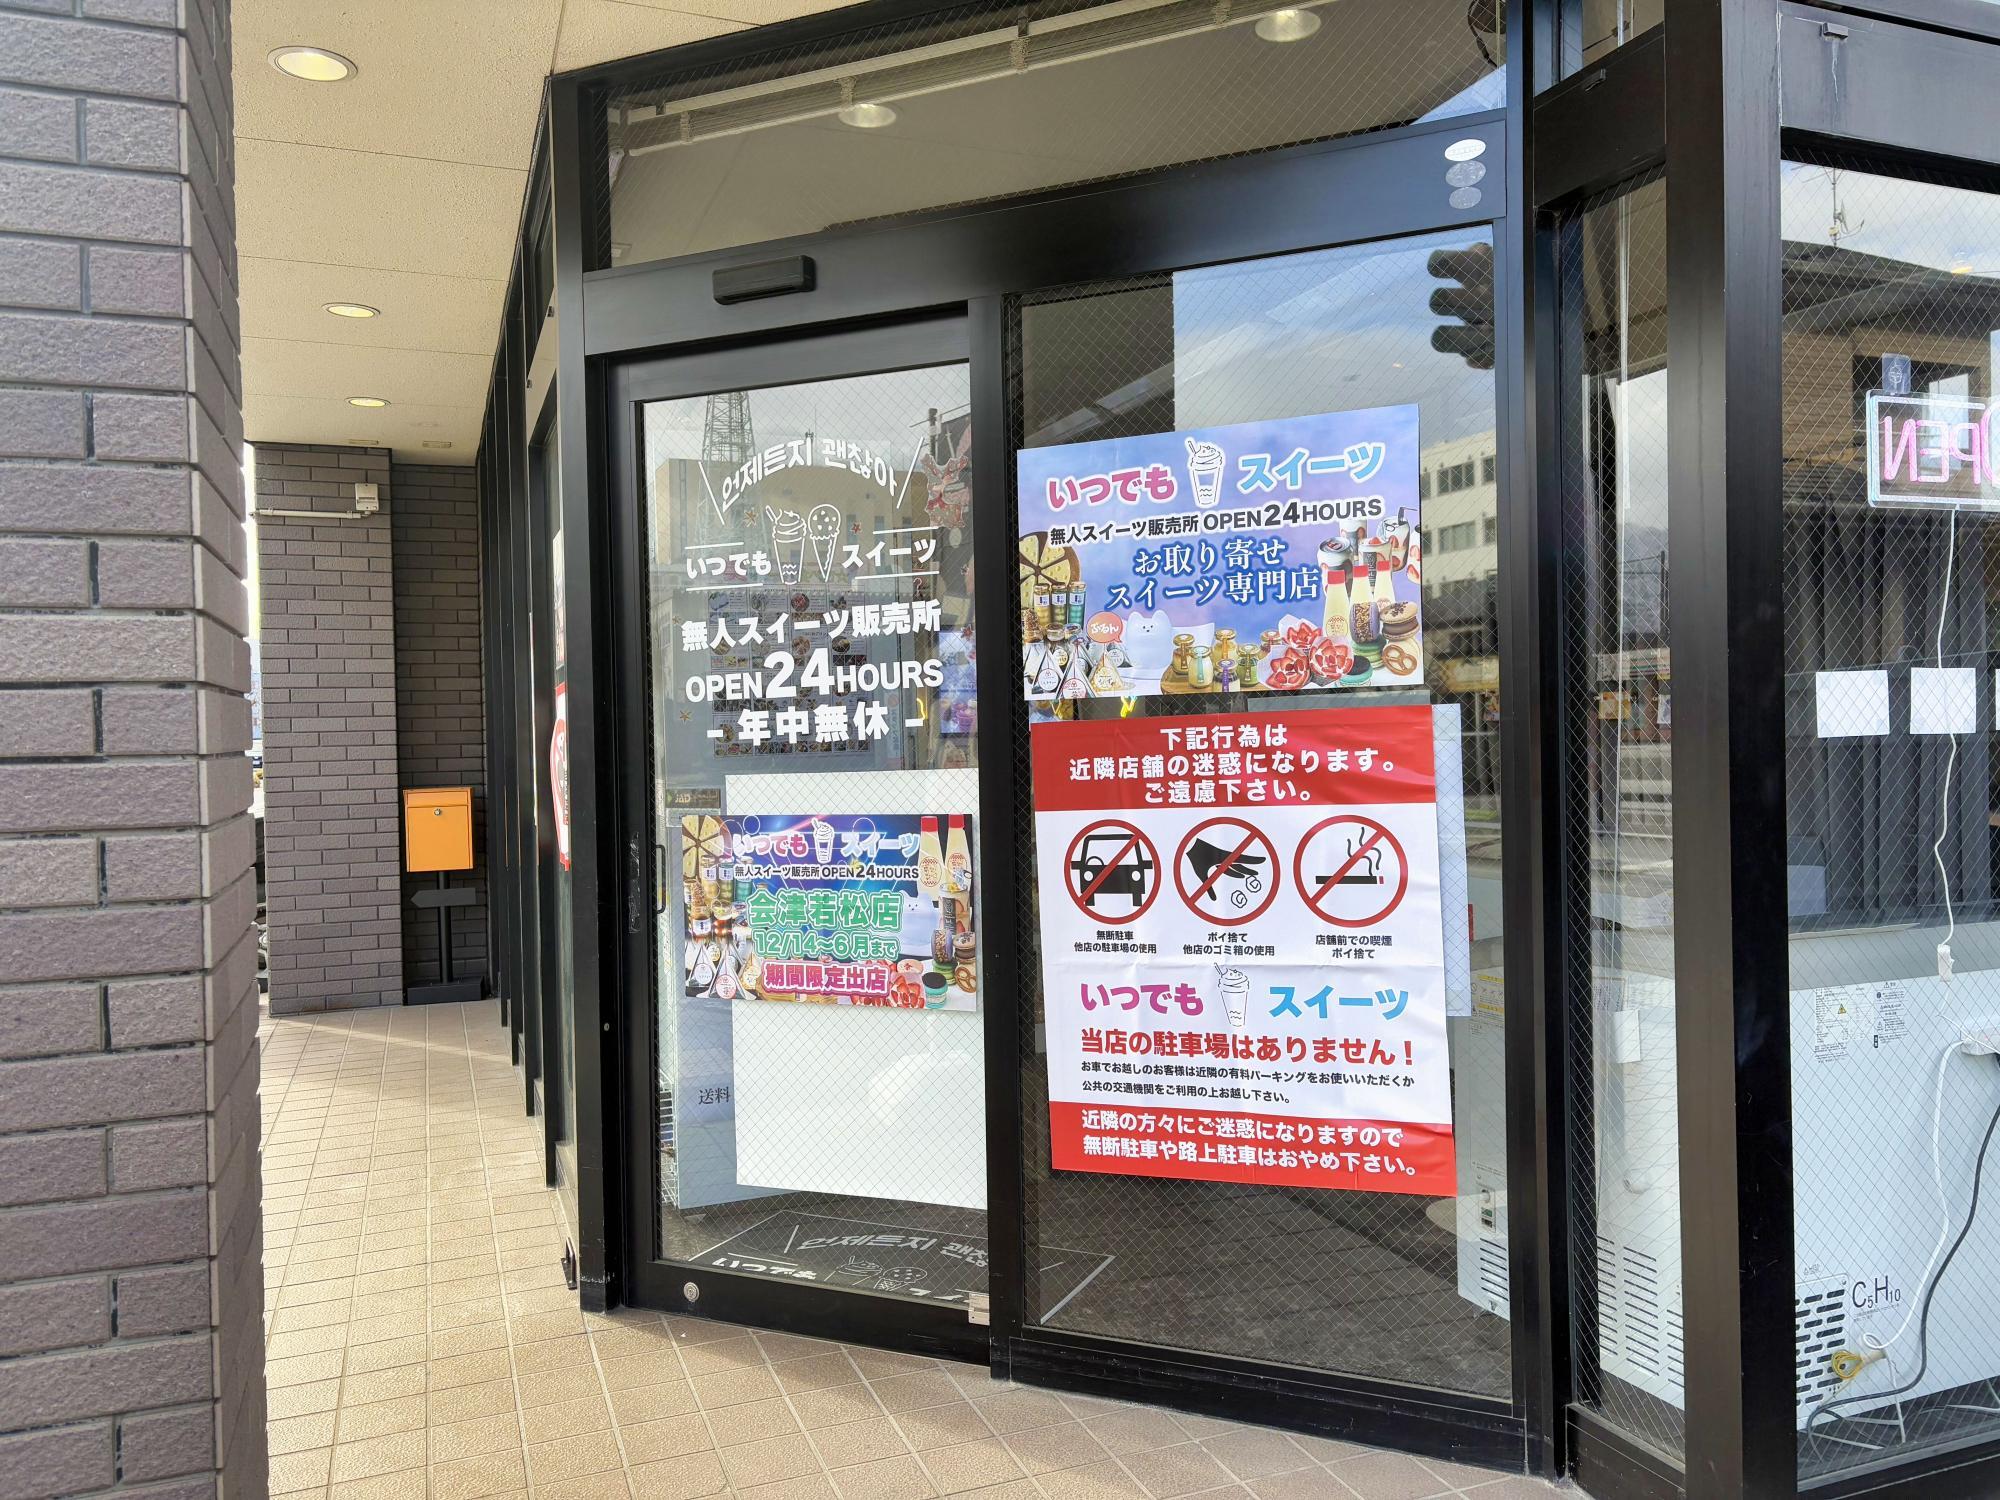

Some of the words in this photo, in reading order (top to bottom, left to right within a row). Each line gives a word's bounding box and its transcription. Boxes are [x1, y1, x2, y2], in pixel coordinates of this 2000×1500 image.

[721, 438, 813, 512] 언제든지
[823, 439, 898, 496] 괜찮아
[1050, 466, 1175, 508] いつでも
[1239, 445, 1383, 490] スイーツ
[1050, 515, 1199, 545] 無人スイーツ販売所
[685, 550, 772, 579] いつでも
[842, 539, 937, 568] スイーツ
[1134, 540, 1287, 575] お取り寄せ
[1108, 567, 1320, 609] スイーツ専門店
[681, 599, 942, 651] 無人スイーツ販売所
[1160, 724, 1288, 750] 下記行為は
[1069, 749, 1395, 780] 近隣店舗の迷惑になります。
[1144, 778, 1312, 804] ご遠慮下さい。
[732, 832, 808, 856] いつでも
[840, 832, 920, 858] スイーツ
[735, 865, 820, 879] 無人スイーツ販売所
[747, 891, 901, 928] 会津若松店
[1074, 942, 1157, 955] 他店の駐車場の使用
[1096, 930, 1134, 942] 無断駐車
[1207, 932, 1248, 943] ポイ捨て
[1315, 934, 1393, 947] 店舗前での喫煙
[1182, 945, 1275, 957] 他店のゴミ箱の使用
[1332, 948, 1375, 959] ポイ捨て
[764, 964, 889, 993] 期間限定出店
[1079, 982, 1204, 1016] いつでも
[1269, 986, 1409, 1020] スイーツ
[1080, 1028, 1413, 1066] 当店の駐車場はありません！
[698, 1086, 731, 1105] 送料
[1081, 1109, 1404, 1148] 近隣の方々にご迷惑になりますので
[1083, 1133, 1417, 1177] 無断駐車や路上駐車はおやめ下さい。
[797, 1235, 938, 1251] 언제든지
